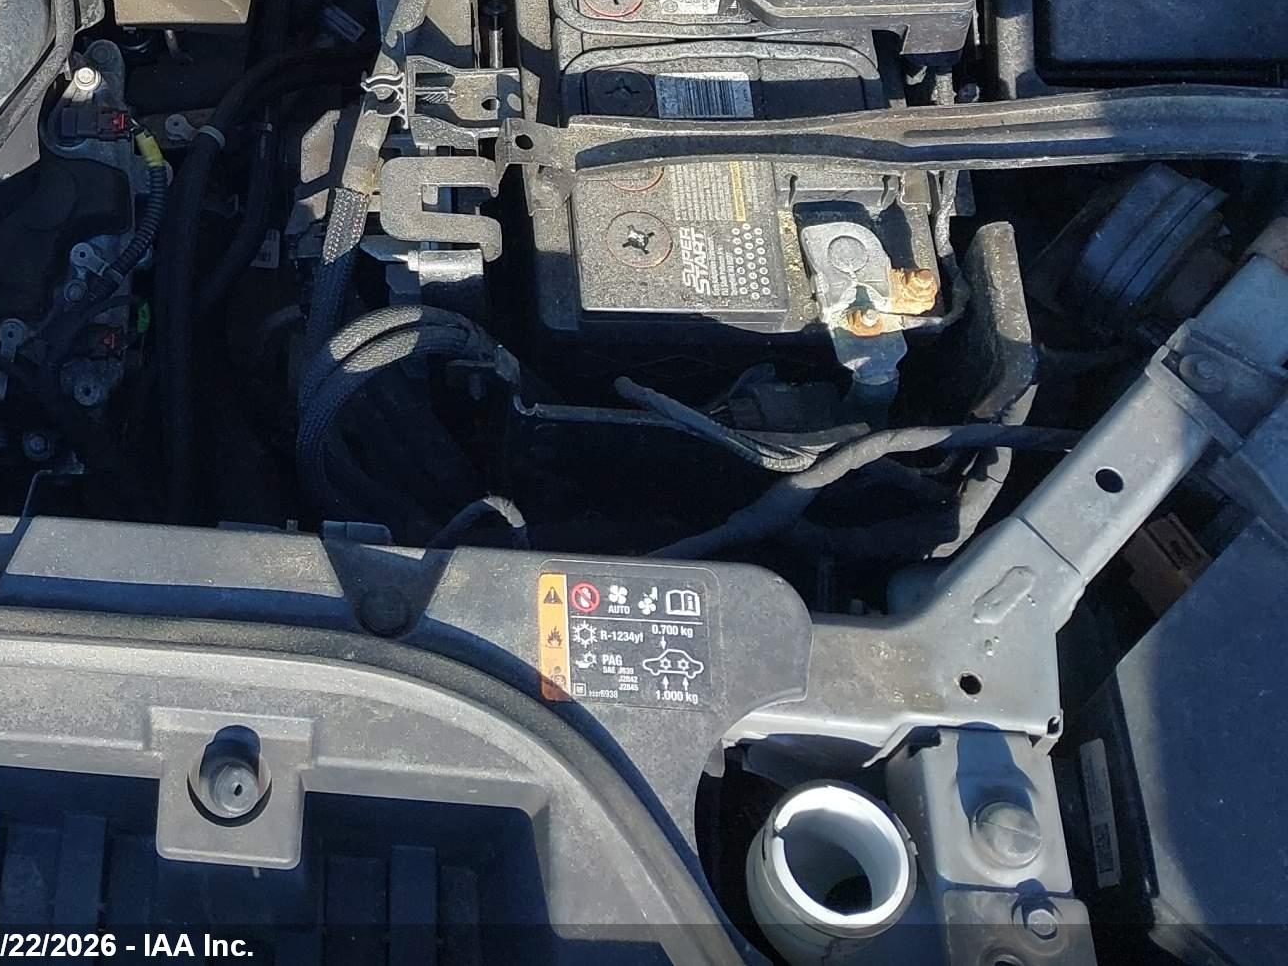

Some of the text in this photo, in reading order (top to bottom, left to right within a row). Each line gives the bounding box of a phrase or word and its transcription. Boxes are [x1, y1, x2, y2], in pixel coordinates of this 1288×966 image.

[680, 227, 696, 288] SUPER
[690, 227, 711, 295] START
[608, 605, 631, 615] AUTO
[651, 624, 694, 638] 0.700 kg
[602, 655, 623, 666] PAG
[655, 690, 699, 704] 1.000 kg
